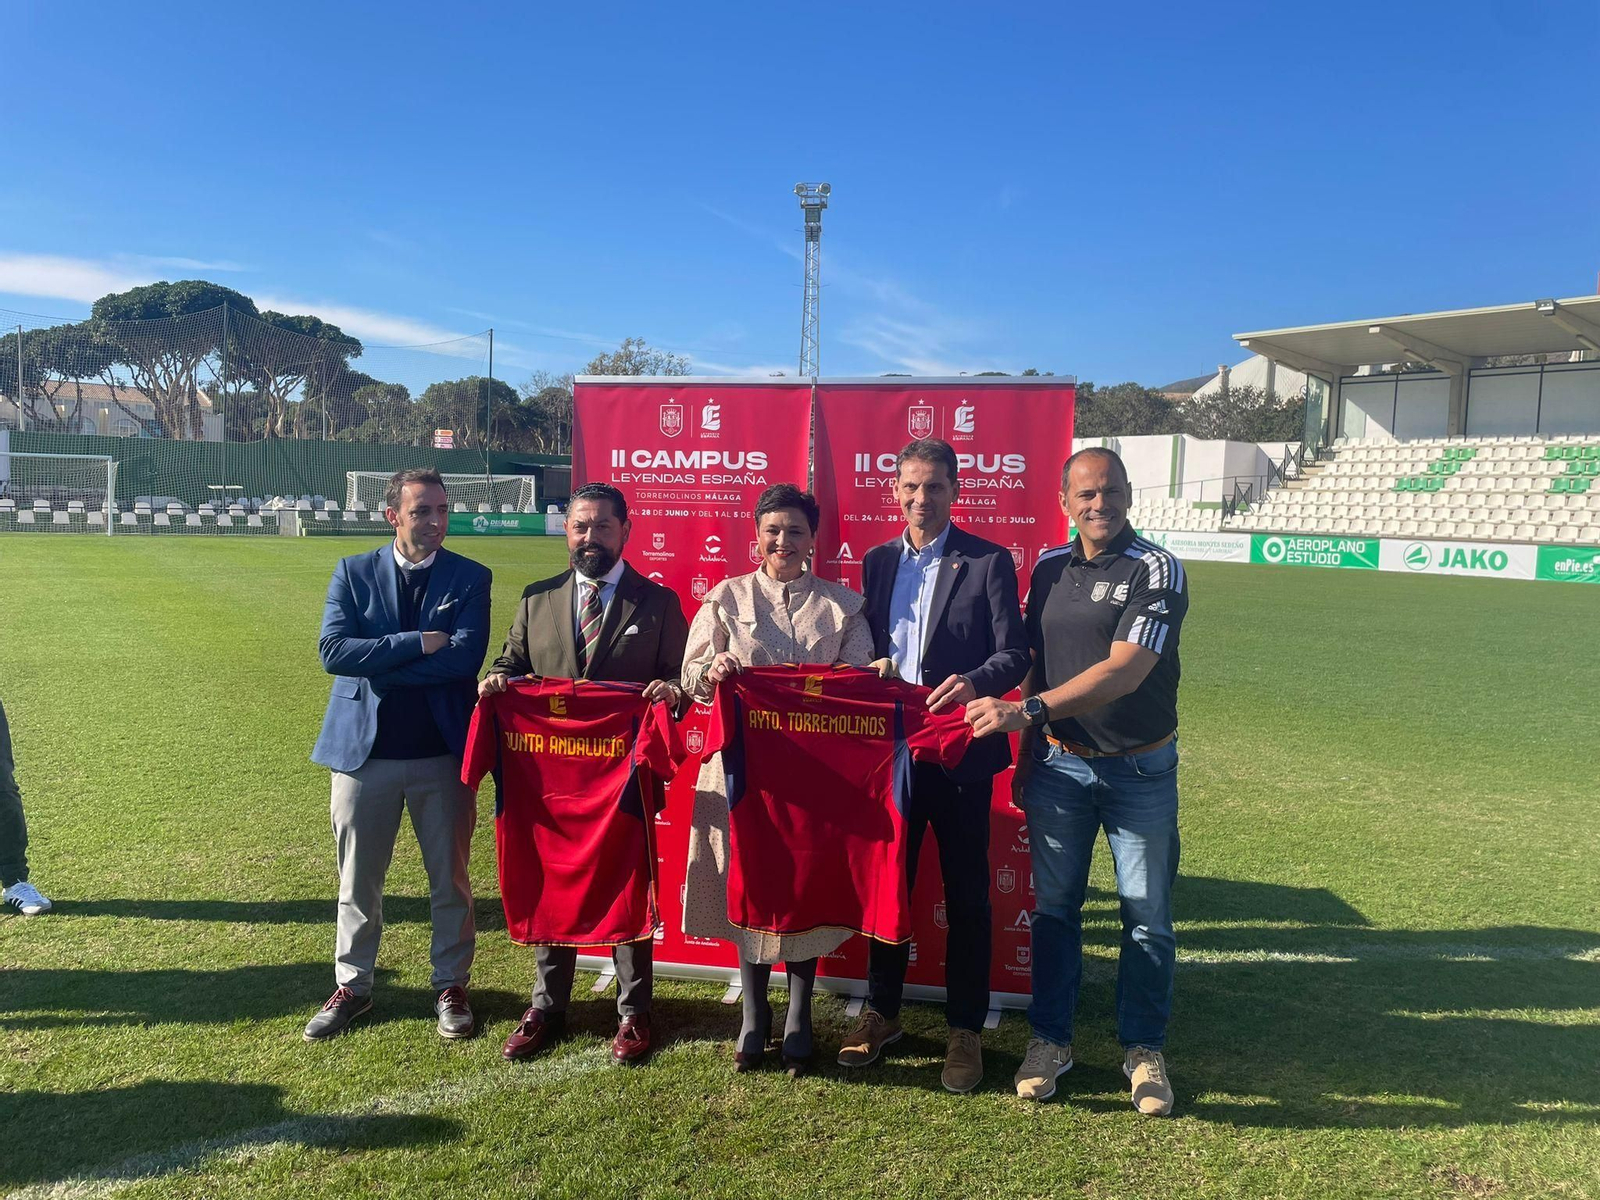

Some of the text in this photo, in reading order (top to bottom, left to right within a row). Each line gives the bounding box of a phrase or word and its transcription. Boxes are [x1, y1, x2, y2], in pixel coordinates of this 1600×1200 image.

[611, 450, 768, 470] II CAMPUS
[855, 454, 1026, 474] II CPUS
[611, 472, 768, 486] LEYENDAS ESPAÑA
[704, 492, 742, 501] MÁLAGA
[958, 497, 996, 505] MÁLAGA
[1287, 539, 1365, 553] AEROPLANO
[1287, 551, 1340, 564] ESTUDIO
[1438, 548, 1508, 571] JAKO
[1554, 558, 1594, 573] enPie.es
[750, 710, 886, 736] AYTO. TORREMOLINOS
[504, 731, 626, 758] JUNTA ANDALUCÍA
